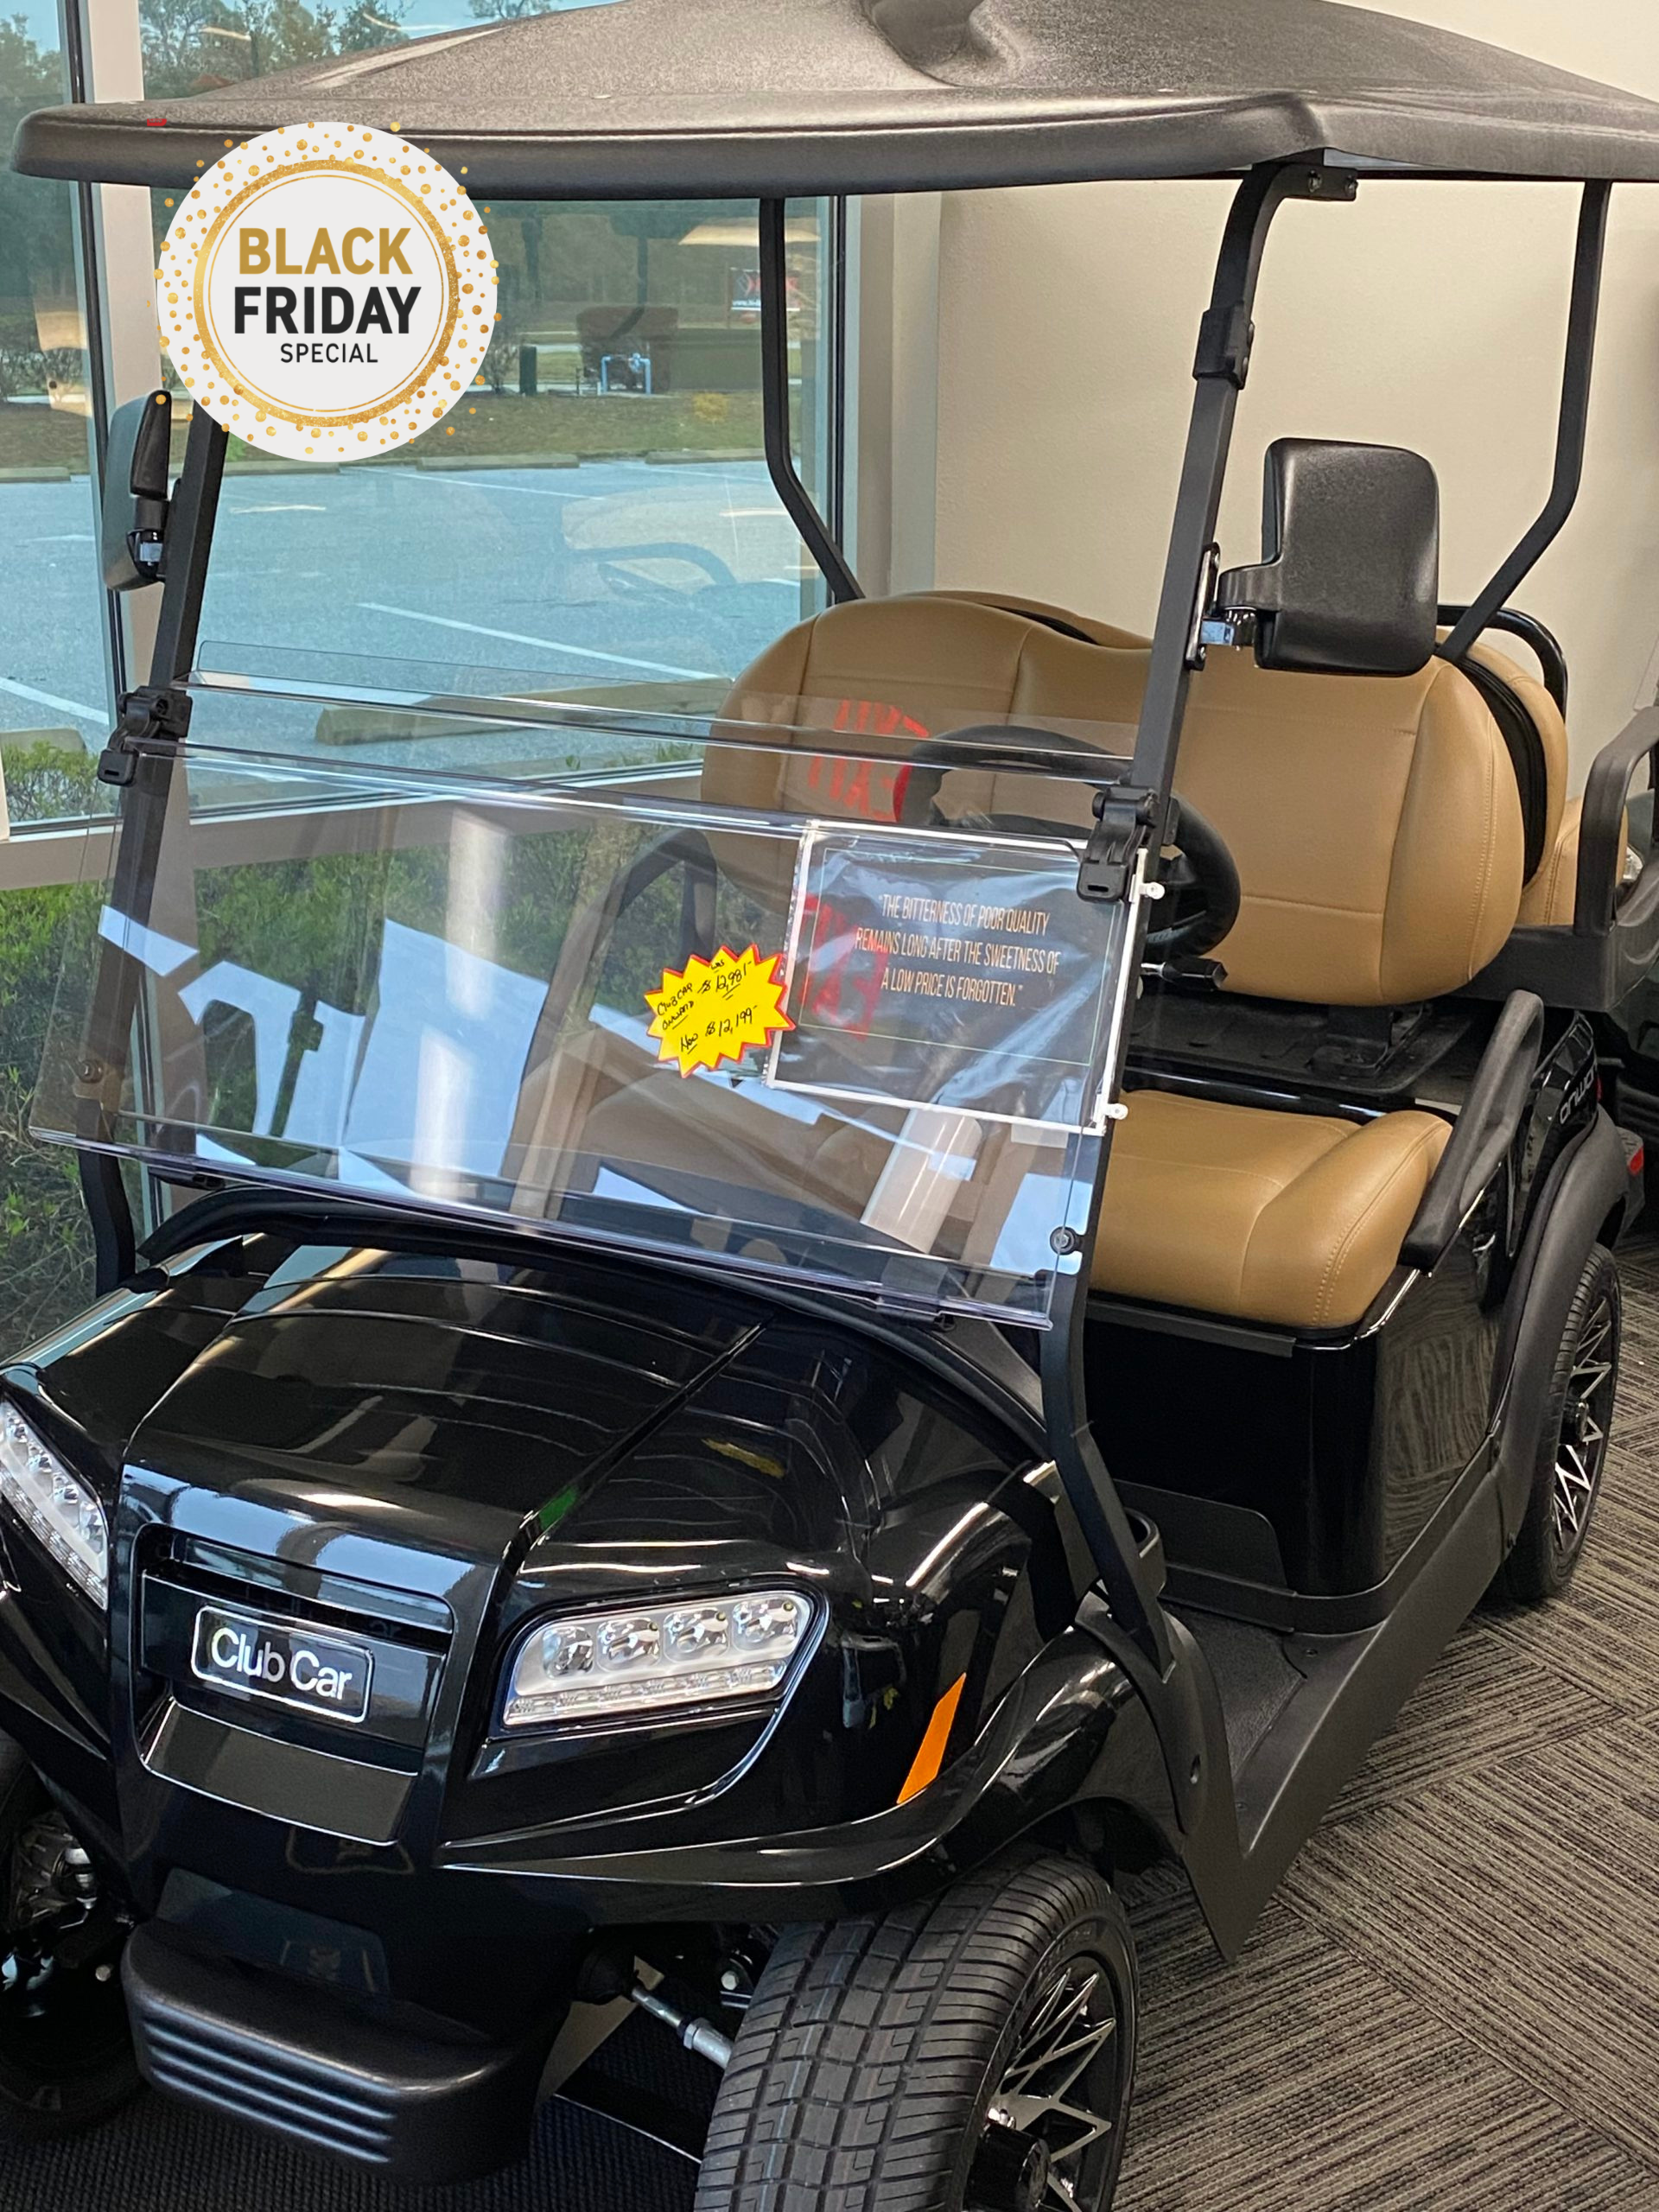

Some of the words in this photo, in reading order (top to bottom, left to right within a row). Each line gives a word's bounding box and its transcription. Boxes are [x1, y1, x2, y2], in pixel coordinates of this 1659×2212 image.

[901, 896, 963, 926] BITTERNESS
[963, 903, 978, 927] OF
[976, 905, 1004, 931] POOR
[1005, 908, 1051, 937] QUALITY
[855, 926, 901, 955] REMAINS
[900, 932, 929, 958] LONG
[928, 936, 962, 963] AFTER
[963, 940, 983, 965] THE
[983, 943, 1046, 973] SWEETNESS
[1046, 949, 1062, 976] OF
[880, 967, 889, 989] A
[890, 968, 915, 993] LOW
[914, 970, 945, 997] PRICE
[944, 975, 957, 999] IS
[211, 1626, 286, 1683] Club
[290, 1649, 353, 1700] Car
